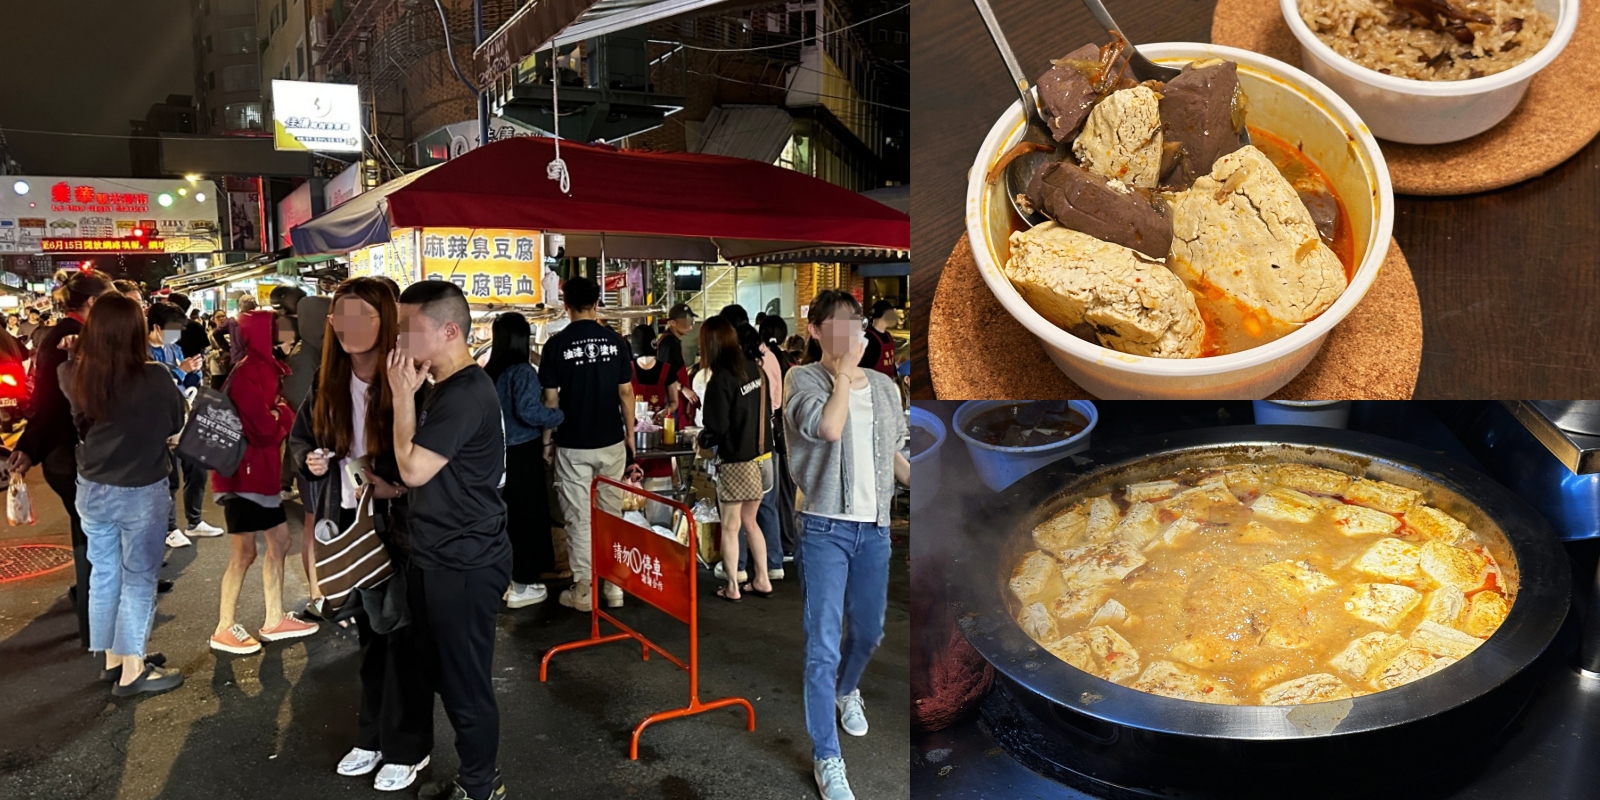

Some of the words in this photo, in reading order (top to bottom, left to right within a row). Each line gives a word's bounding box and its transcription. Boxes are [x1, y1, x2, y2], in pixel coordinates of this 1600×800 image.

[424, 234, 534, 262] 麻辣臭豆腐
[613, 542, 630, 567] 請勿
[642, 554, 663, 580] 停車
